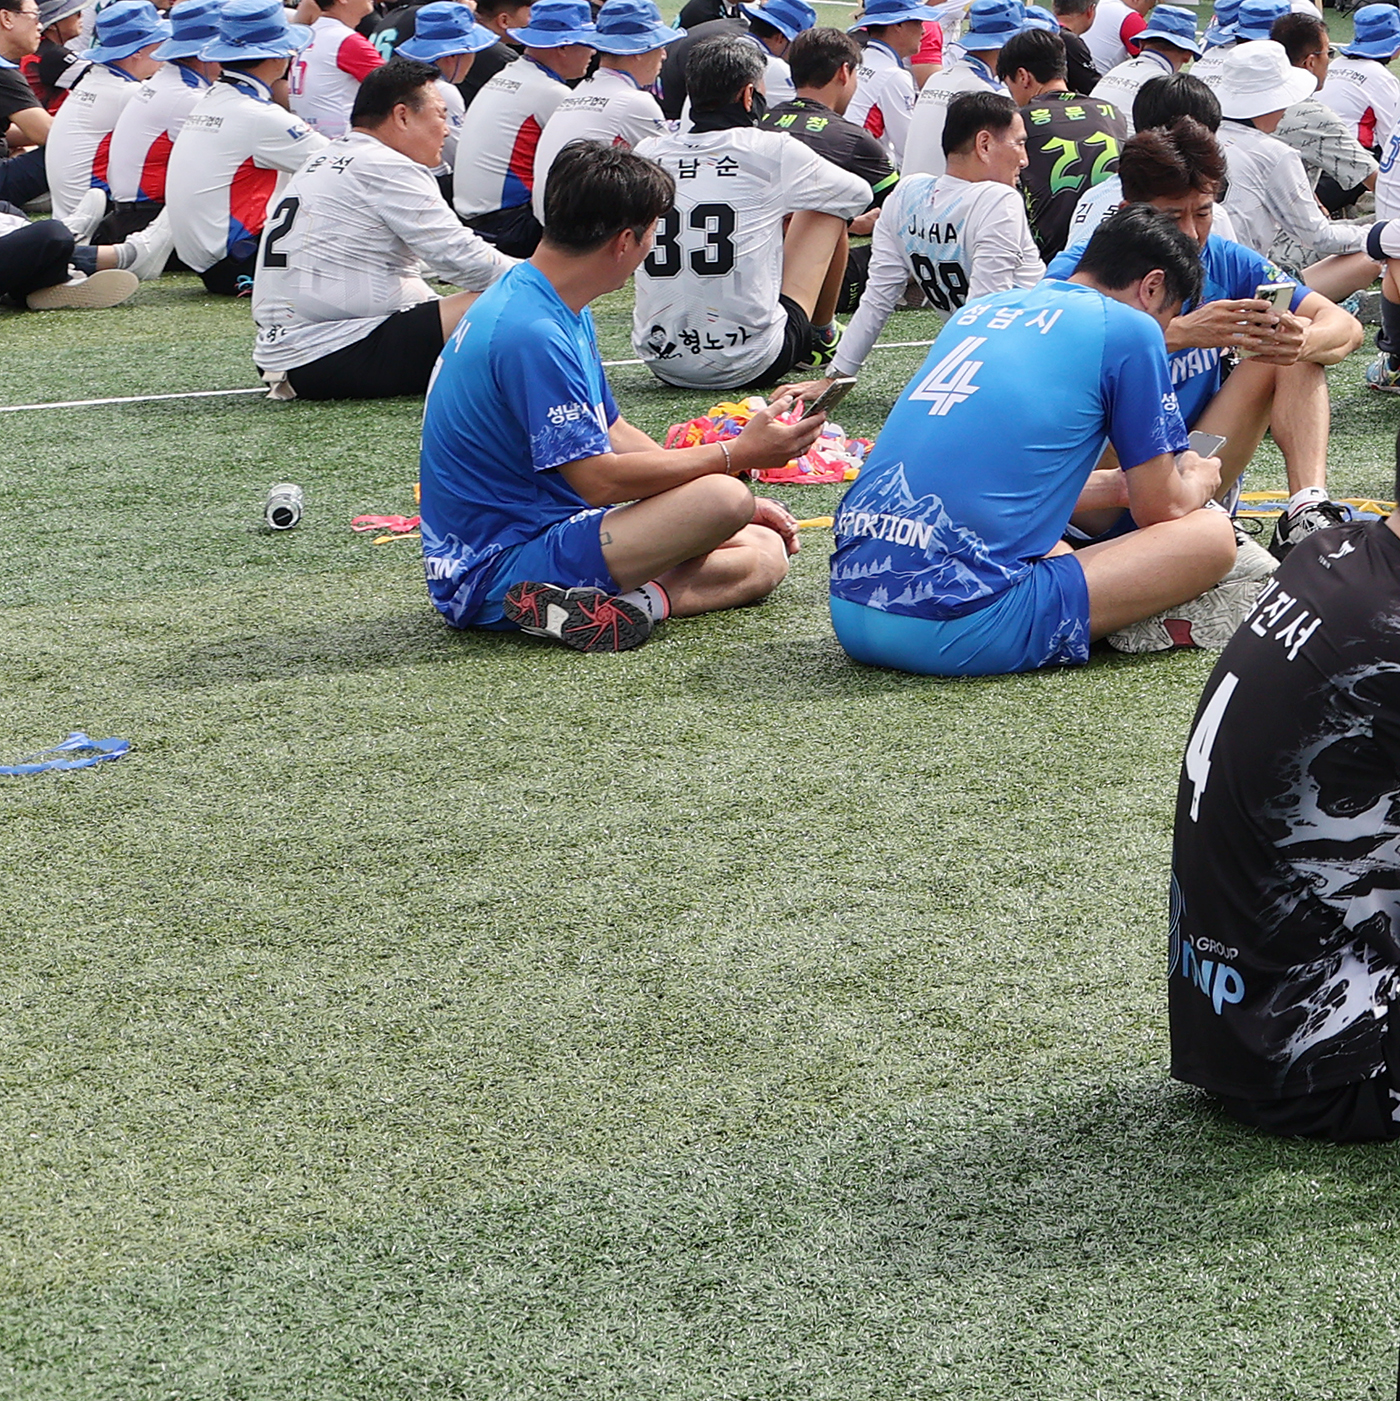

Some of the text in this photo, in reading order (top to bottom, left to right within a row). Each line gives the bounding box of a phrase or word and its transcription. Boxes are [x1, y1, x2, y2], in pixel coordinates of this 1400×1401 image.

[1030, 104, 1116, 126] 홍문기
[1041, 130, 1120, 196] 22
[262, 196, 301, 270] 2
[643, 201, 738, 278] 33
[928, 222, 959, 245] HA
[909, 252, 970, 312] 88
[956, 303, 1064, 335] 성남시
[907, 335, 989, 417] 4
[1184, 670, 1241, 824] 4
[1195, 935, 1239, 961] GROUP
